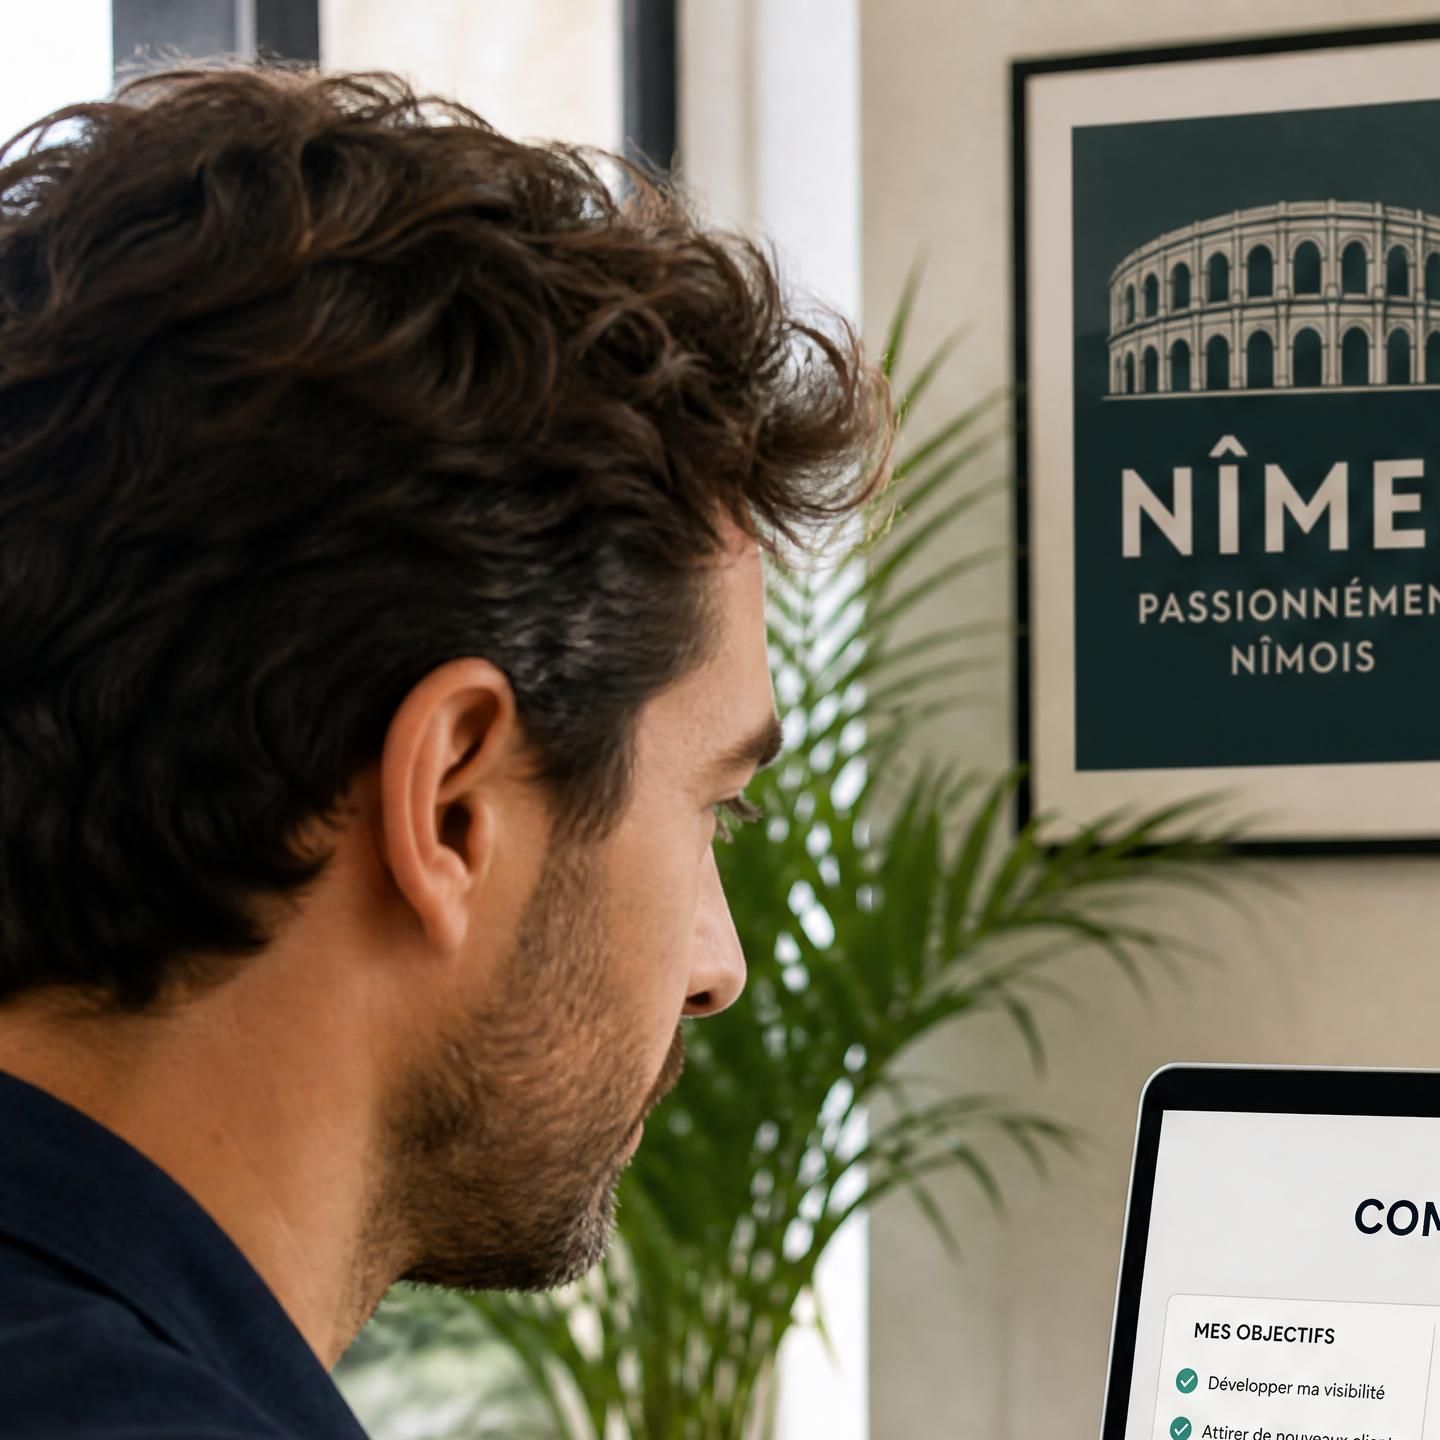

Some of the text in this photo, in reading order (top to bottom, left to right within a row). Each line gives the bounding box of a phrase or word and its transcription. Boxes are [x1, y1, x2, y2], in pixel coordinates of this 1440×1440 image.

[1231, 635, 1375, 675] NÎMOIS
[1194, 1322, 1335, 1345] MES OBJECTIFS
[1208, 1375, 1385, 1400] Développer ma visibilité
[1201, 1424, 1250, 1440] Attirer
